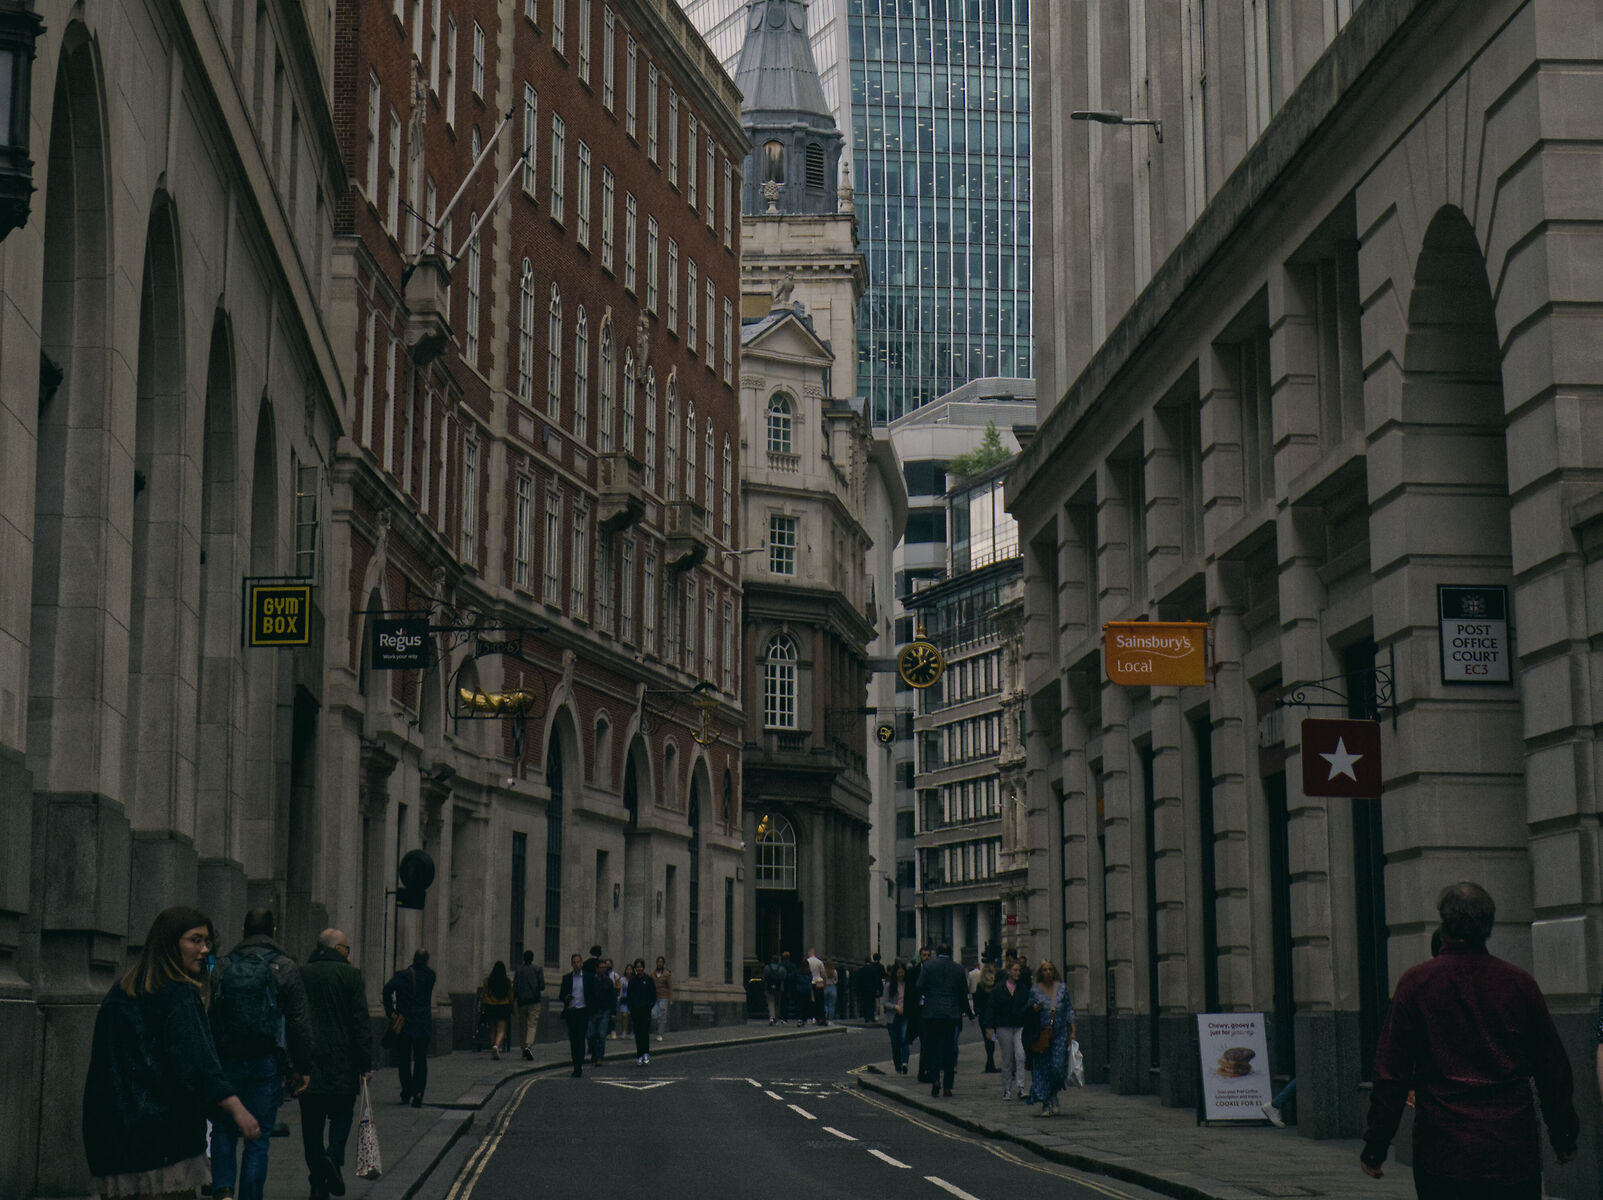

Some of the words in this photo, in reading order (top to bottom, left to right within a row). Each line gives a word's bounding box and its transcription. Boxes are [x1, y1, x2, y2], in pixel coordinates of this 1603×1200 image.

[262, 616, 299, 634] BOX
[1457, 624, 1492, 635] POST
[379, 633, 422, 652] Regus
[1116, 634, 1191, 651] Sainsbury's
[1452, 637, 1498, 648] OFFICE
[1452, 651, 1499, 662] COURT
[1117, 659, 1153, 673] Local
[1465, 664, 1489, 675] EC3
